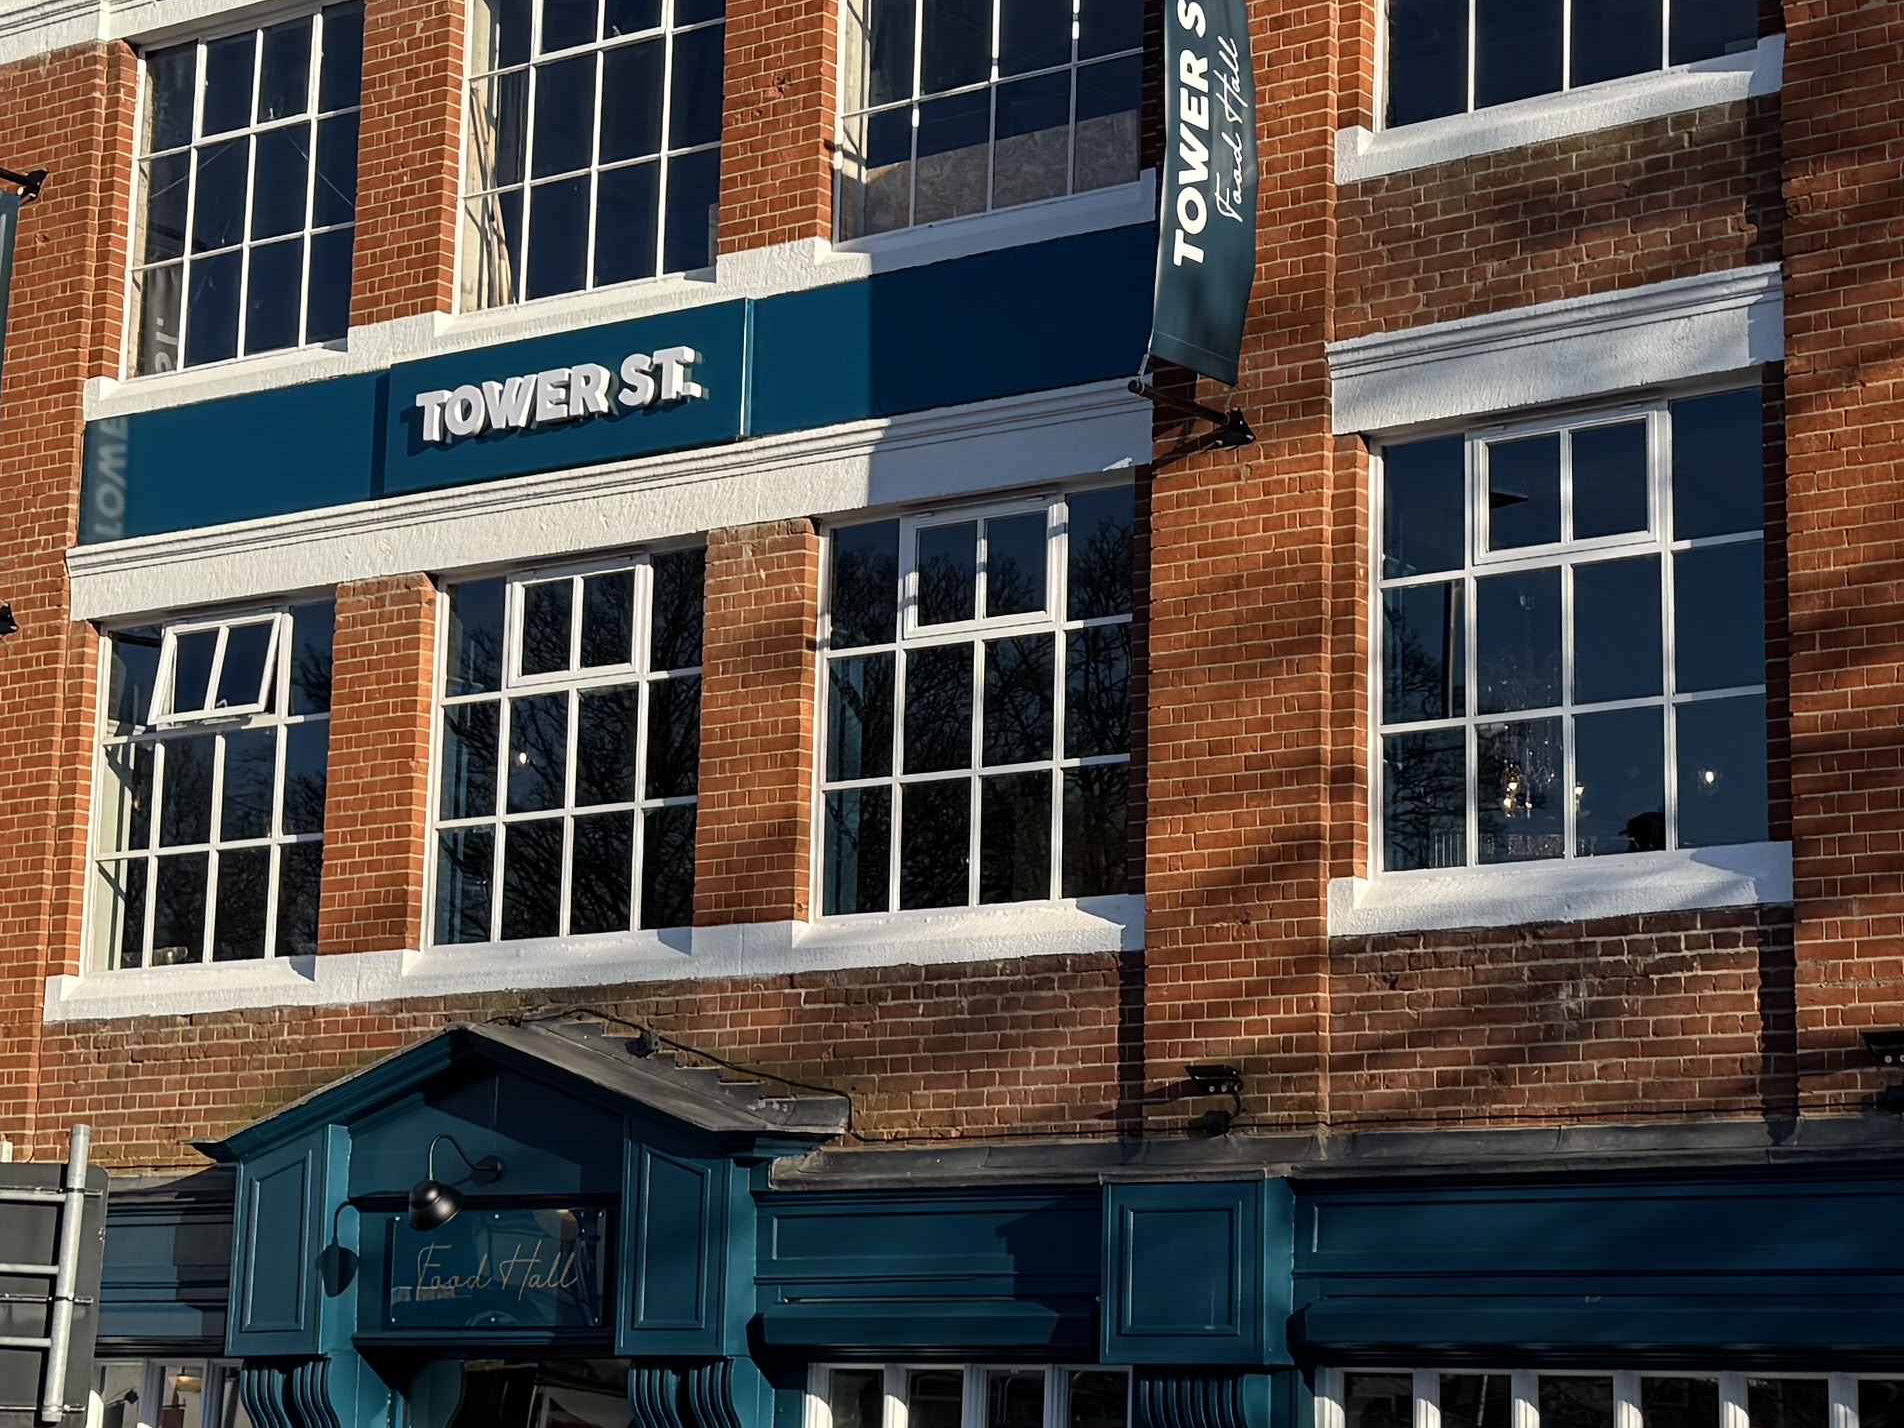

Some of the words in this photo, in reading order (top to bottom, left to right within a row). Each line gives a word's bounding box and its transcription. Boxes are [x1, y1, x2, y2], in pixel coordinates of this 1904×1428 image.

[1213, 35, 1248, 124] Hall
[1173, 48, 1209, 267] TOWER
[1215, 131, 1243, 223] Food
[416, 362, 610, 441] TOWER
[619, 345, 702, 407] ST.
[416, 1242, 492, 1301] Food
[499, 1239, 578, 1302] Hall
